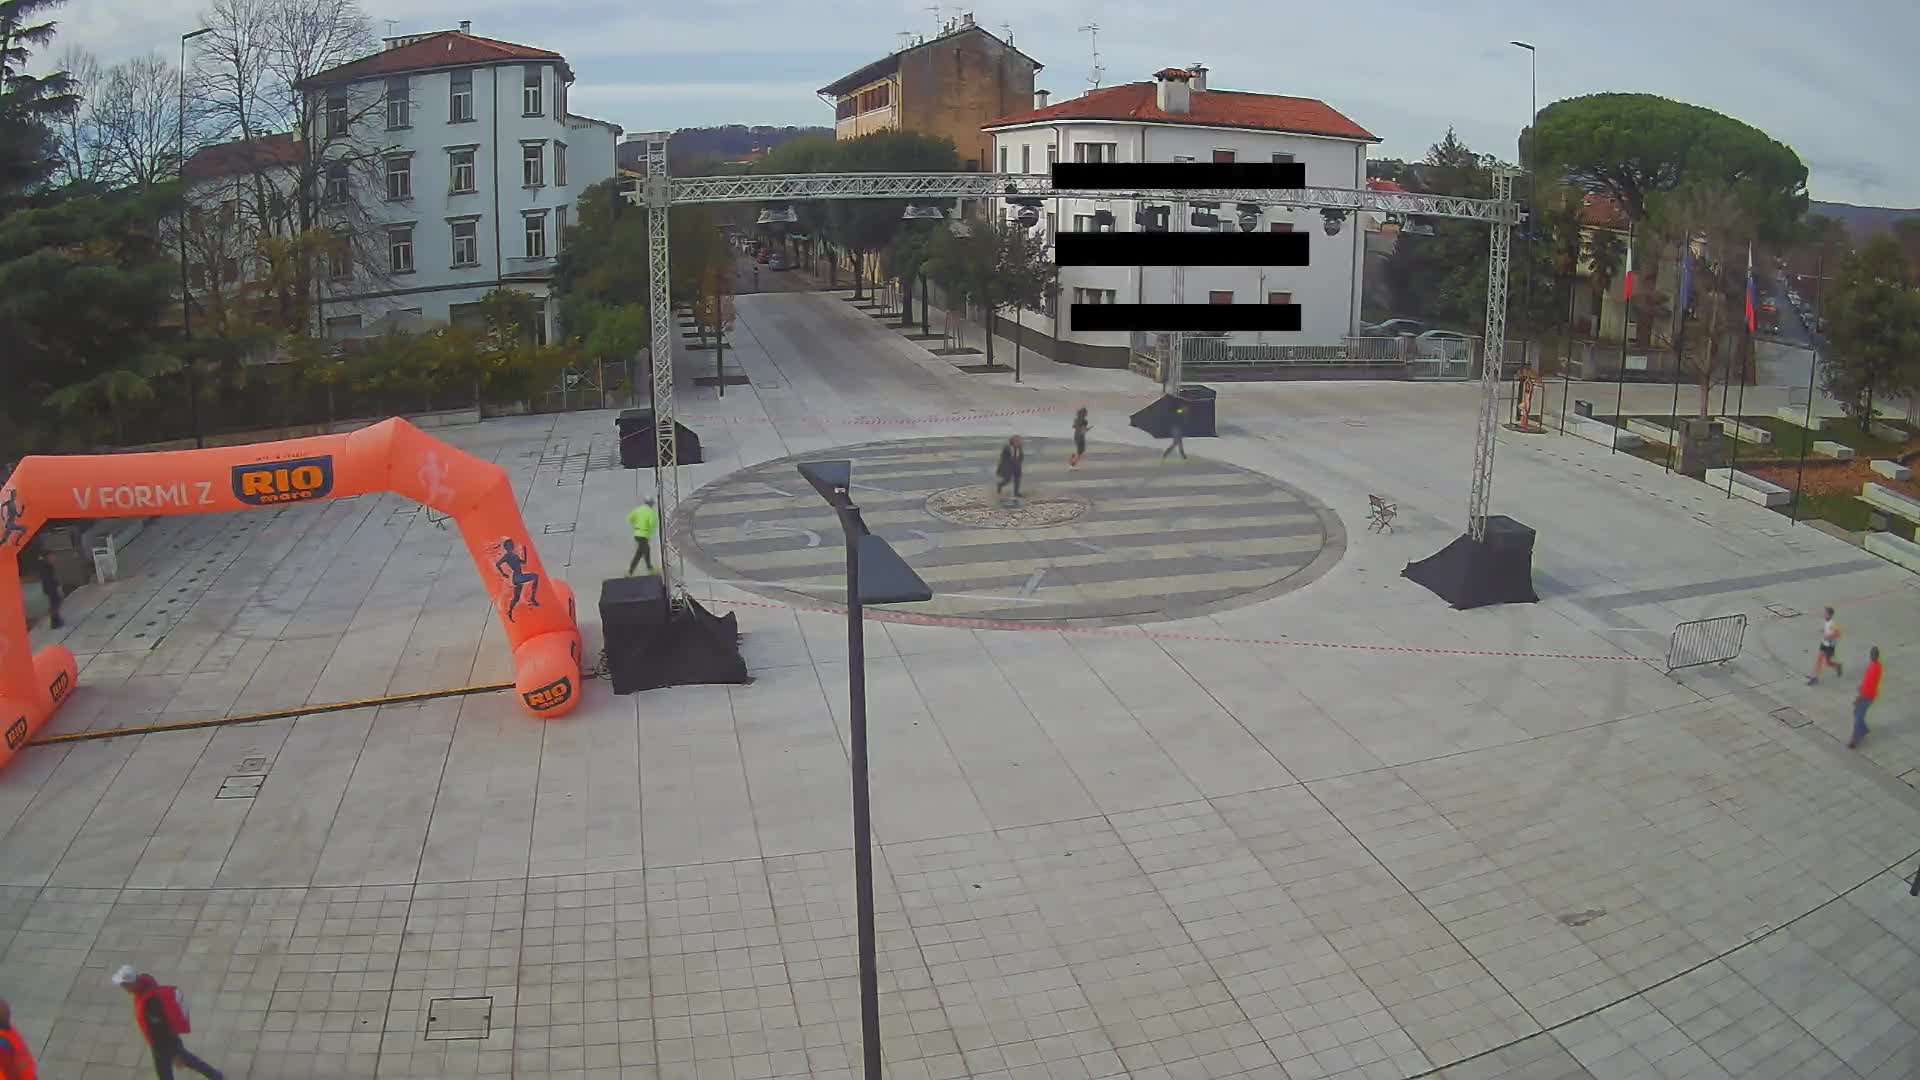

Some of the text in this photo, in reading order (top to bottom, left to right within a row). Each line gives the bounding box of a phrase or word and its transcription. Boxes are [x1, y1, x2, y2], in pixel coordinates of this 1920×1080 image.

[242, 465, 323, 496] RIO
[72, 481, 215, 510] V FORMI Z
[528, 683, 567, 705] RIO
